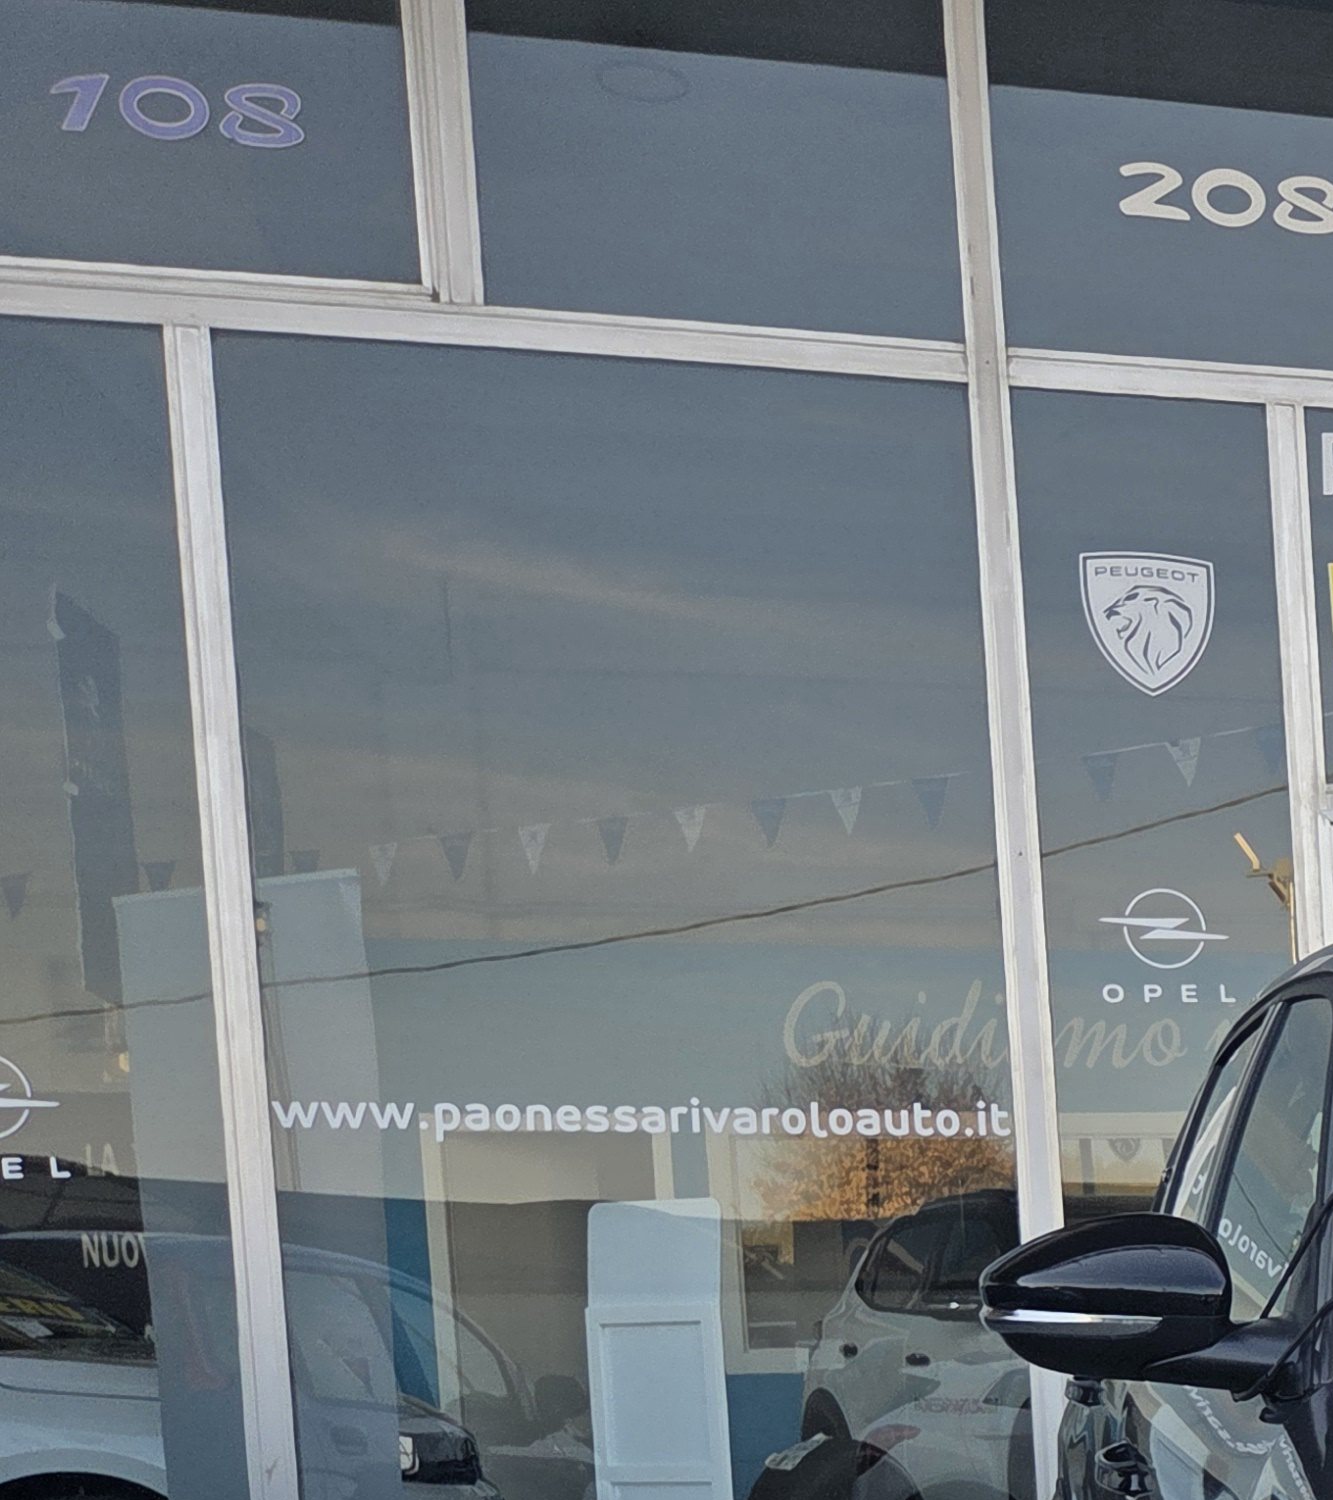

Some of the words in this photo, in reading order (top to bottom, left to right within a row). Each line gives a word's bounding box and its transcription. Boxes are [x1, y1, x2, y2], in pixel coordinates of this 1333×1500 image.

[49, 73, 305, 148] 108
[1093, 565, 1200, 586] PEUGEOT
[1102, 983, 1237, 1004] OPEL
[271, 1096, 1012, 1142] www.paonessarivaroloauto.it
